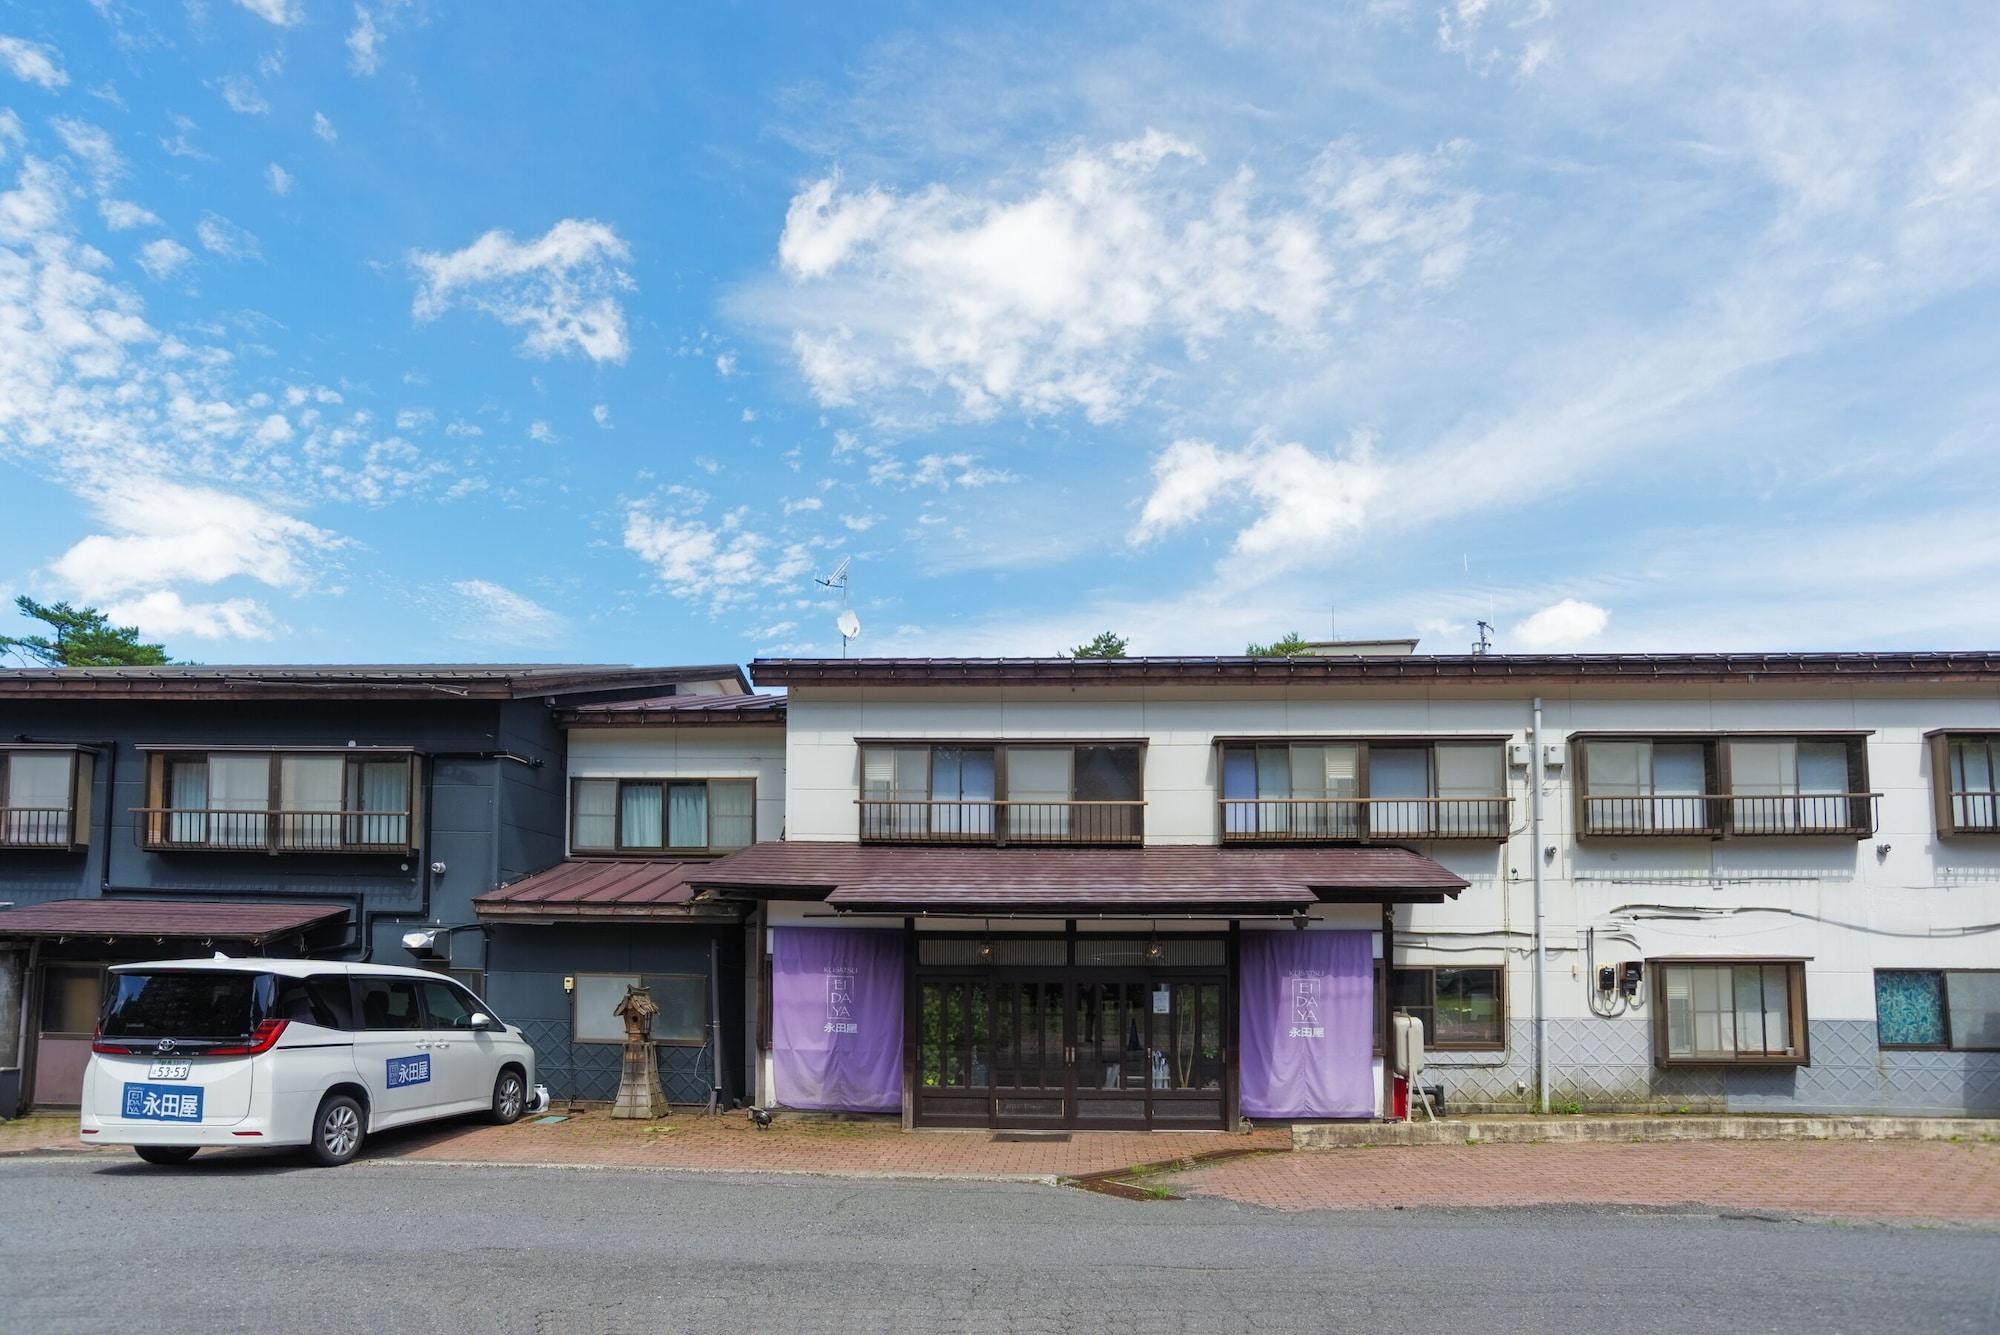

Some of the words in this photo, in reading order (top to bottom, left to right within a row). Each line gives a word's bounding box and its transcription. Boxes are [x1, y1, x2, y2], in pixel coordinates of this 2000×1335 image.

[834, 979, 847, 990] EI
[1300, 983, 1313, 994] EI
[831, 992, 852, 1004] DA
[1296, 996, 1318, 1008] DA
[832, 1006, 851, 1017] YA
[1296, 1009, 1318, 1021] YA
[398, 1061, 429, 1084] 永田屋
[142, 1092, 198, 1117] 永田屋
